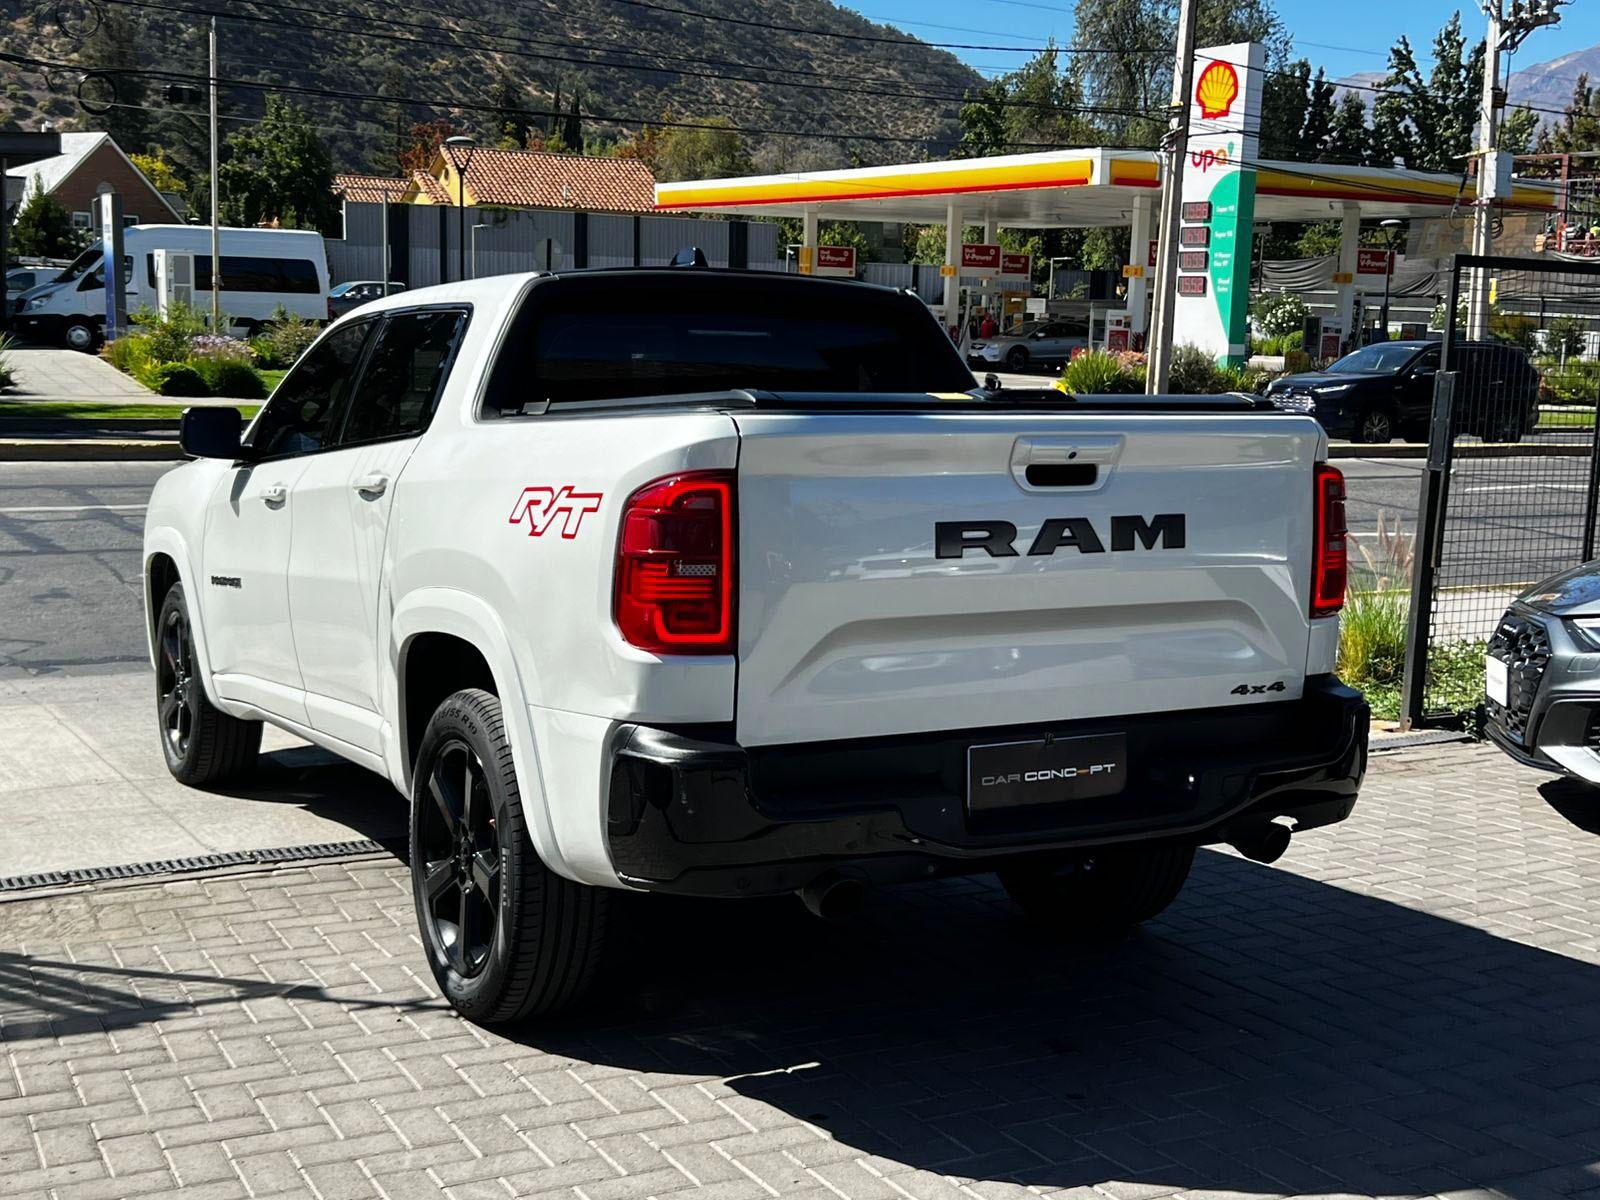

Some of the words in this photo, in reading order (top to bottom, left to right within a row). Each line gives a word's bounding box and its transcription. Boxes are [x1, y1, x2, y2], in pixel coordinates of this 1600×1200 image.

[509, 485, 603, 539] R/T
[935, 513, 1186, 560] RAM
[1230, 681, 1286, 695] 4x4
[981, 773, 1021, 786] CAR
